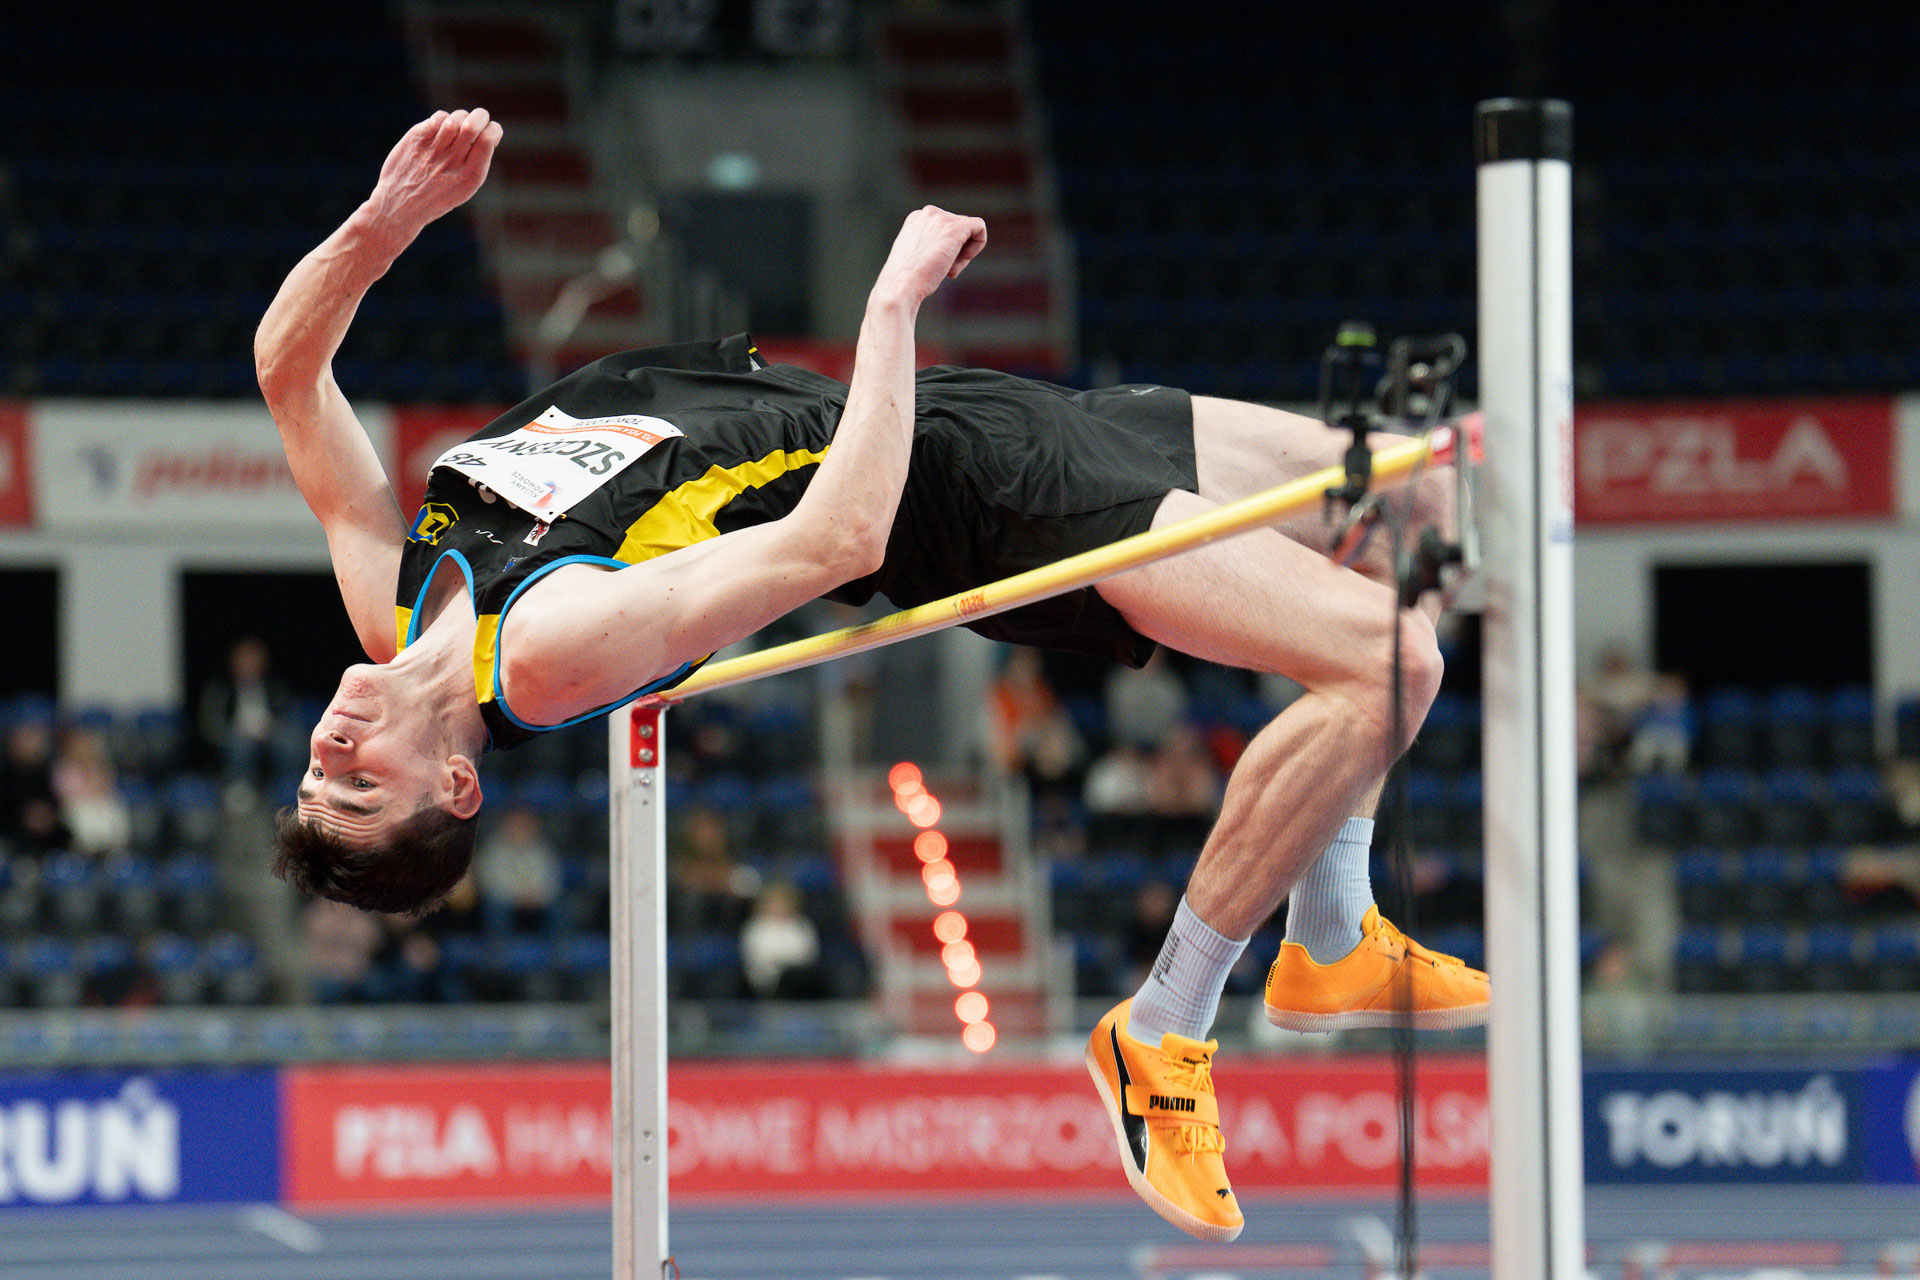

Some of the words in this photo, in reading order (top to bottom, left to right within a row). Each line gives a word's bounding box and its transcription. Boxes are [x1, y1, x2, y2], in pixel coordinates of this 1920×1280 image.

[442, 452, 487, 468] 48
[1577, 415, 1849, 494] PZLA
[510, 480, 538, 498] KUJAWY
[1149, 1094, 1196, 1112] PUMA
[1604, 1074, 1850, 1169] TORUŃ
